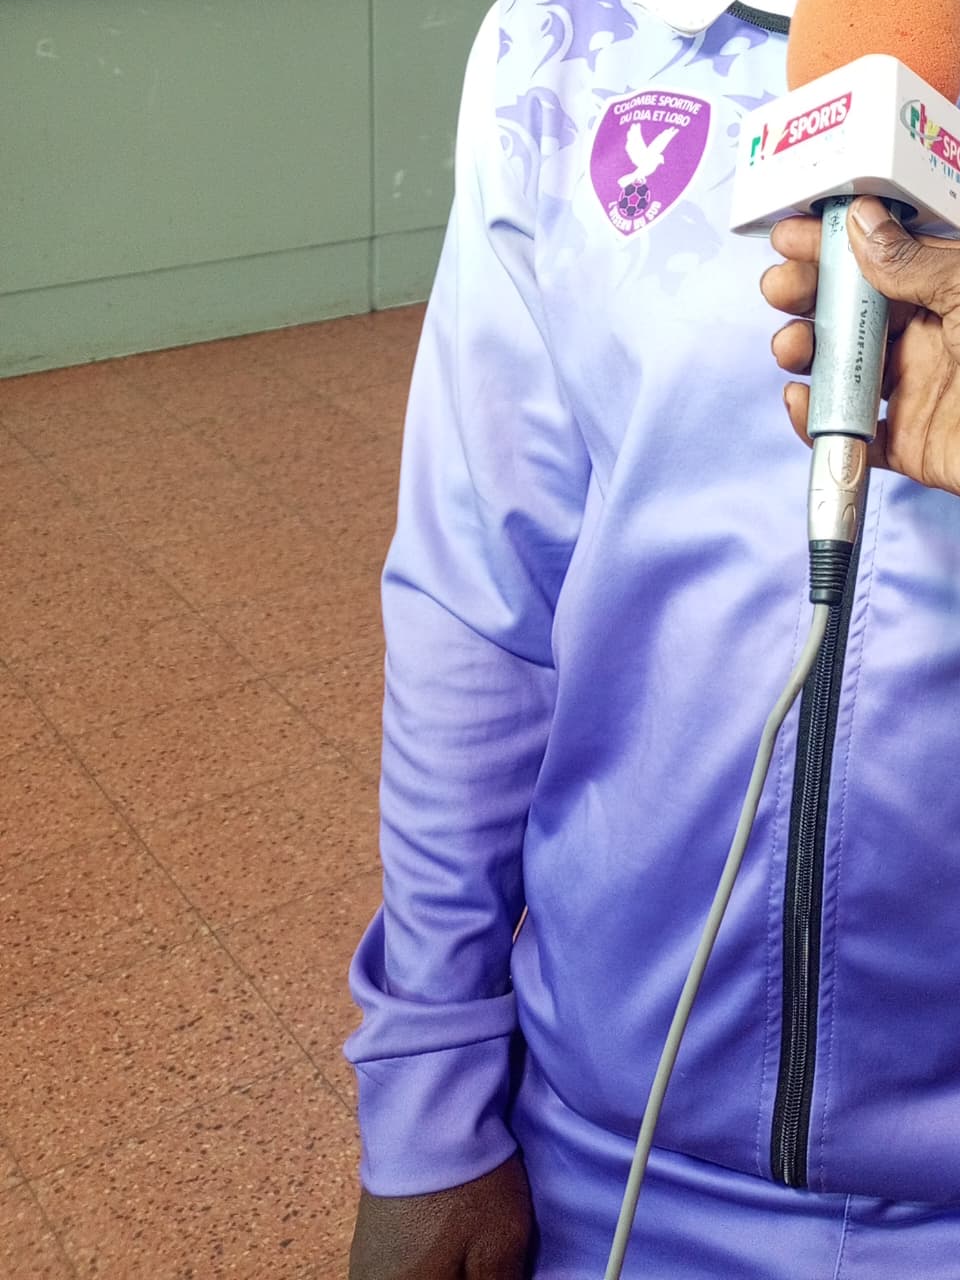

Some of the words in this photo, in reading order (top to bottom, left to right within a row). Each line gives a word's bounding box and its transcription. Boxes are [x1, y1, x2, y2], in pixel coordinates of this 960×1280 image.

[613, 95, 658, 115] COLOMBE
[657, 94, 702, 115] SPORTIVE
[619, 113, 633, 126] DU
[632, 109, 651, 121] DJA
[652, 110, 666, 122] ET
[664, 111, 691, 128] LOBO
[787, 97, 849, 144] SPORTS
